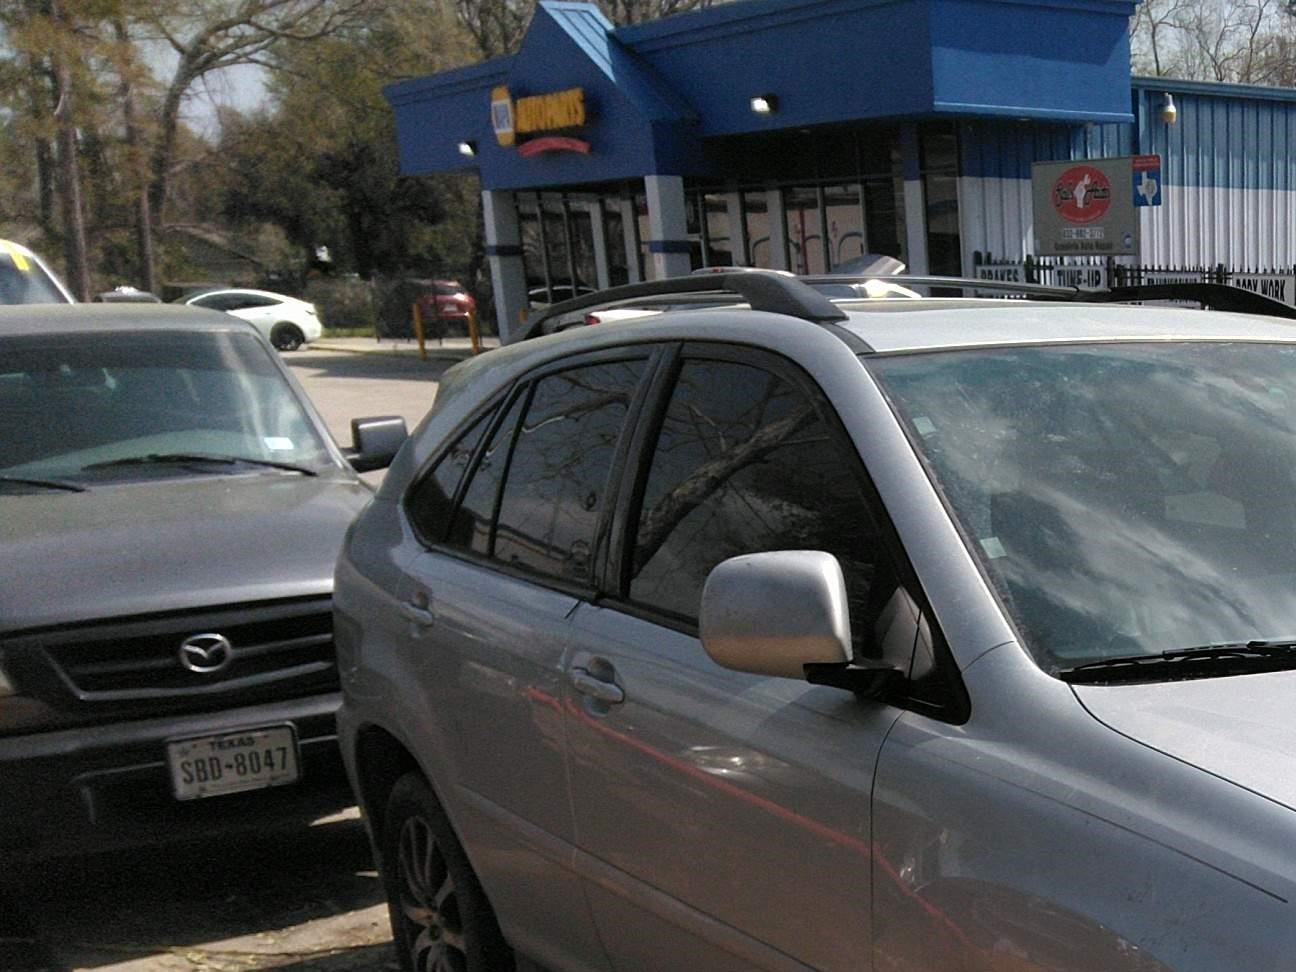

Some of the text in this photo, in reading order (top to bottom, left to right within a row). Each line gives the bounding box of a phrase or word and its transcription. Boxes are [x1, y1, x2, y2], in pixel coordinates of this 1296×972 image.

[1260, 279, 1286, 302] WORK
[209, 736, 255, 751] TEXAS
[181, 746, 288, 784] SBD-8047
